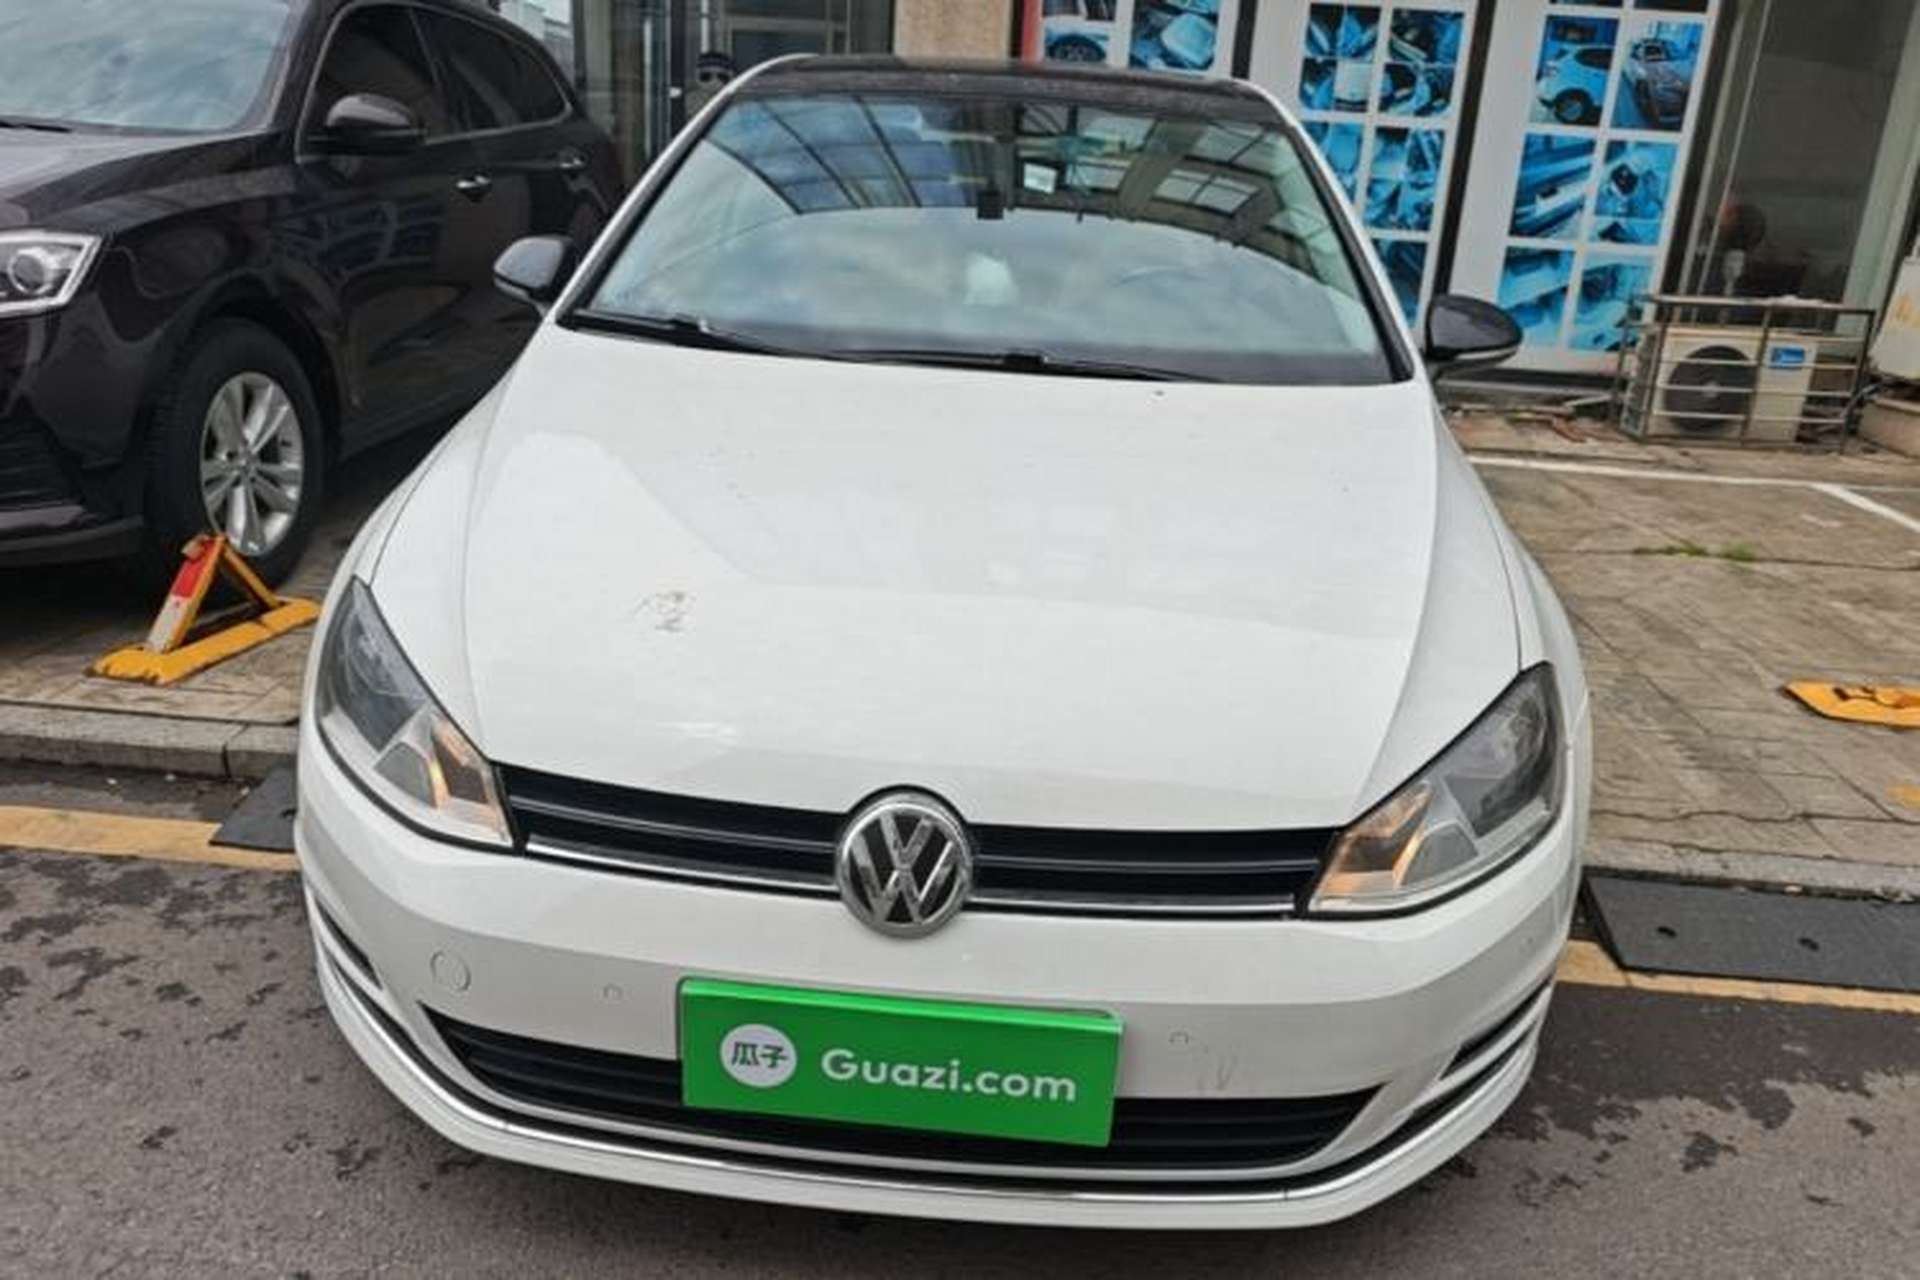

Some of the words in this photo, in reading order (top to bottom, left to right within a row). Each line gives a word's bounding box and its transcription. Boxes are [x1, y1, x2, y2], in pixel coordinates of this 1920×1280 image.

[846, 804, 962, 926] VW
[730, 1041, 787, 1069] 瓜子
[821, 1049, 1076, 1102] Guazi.com
